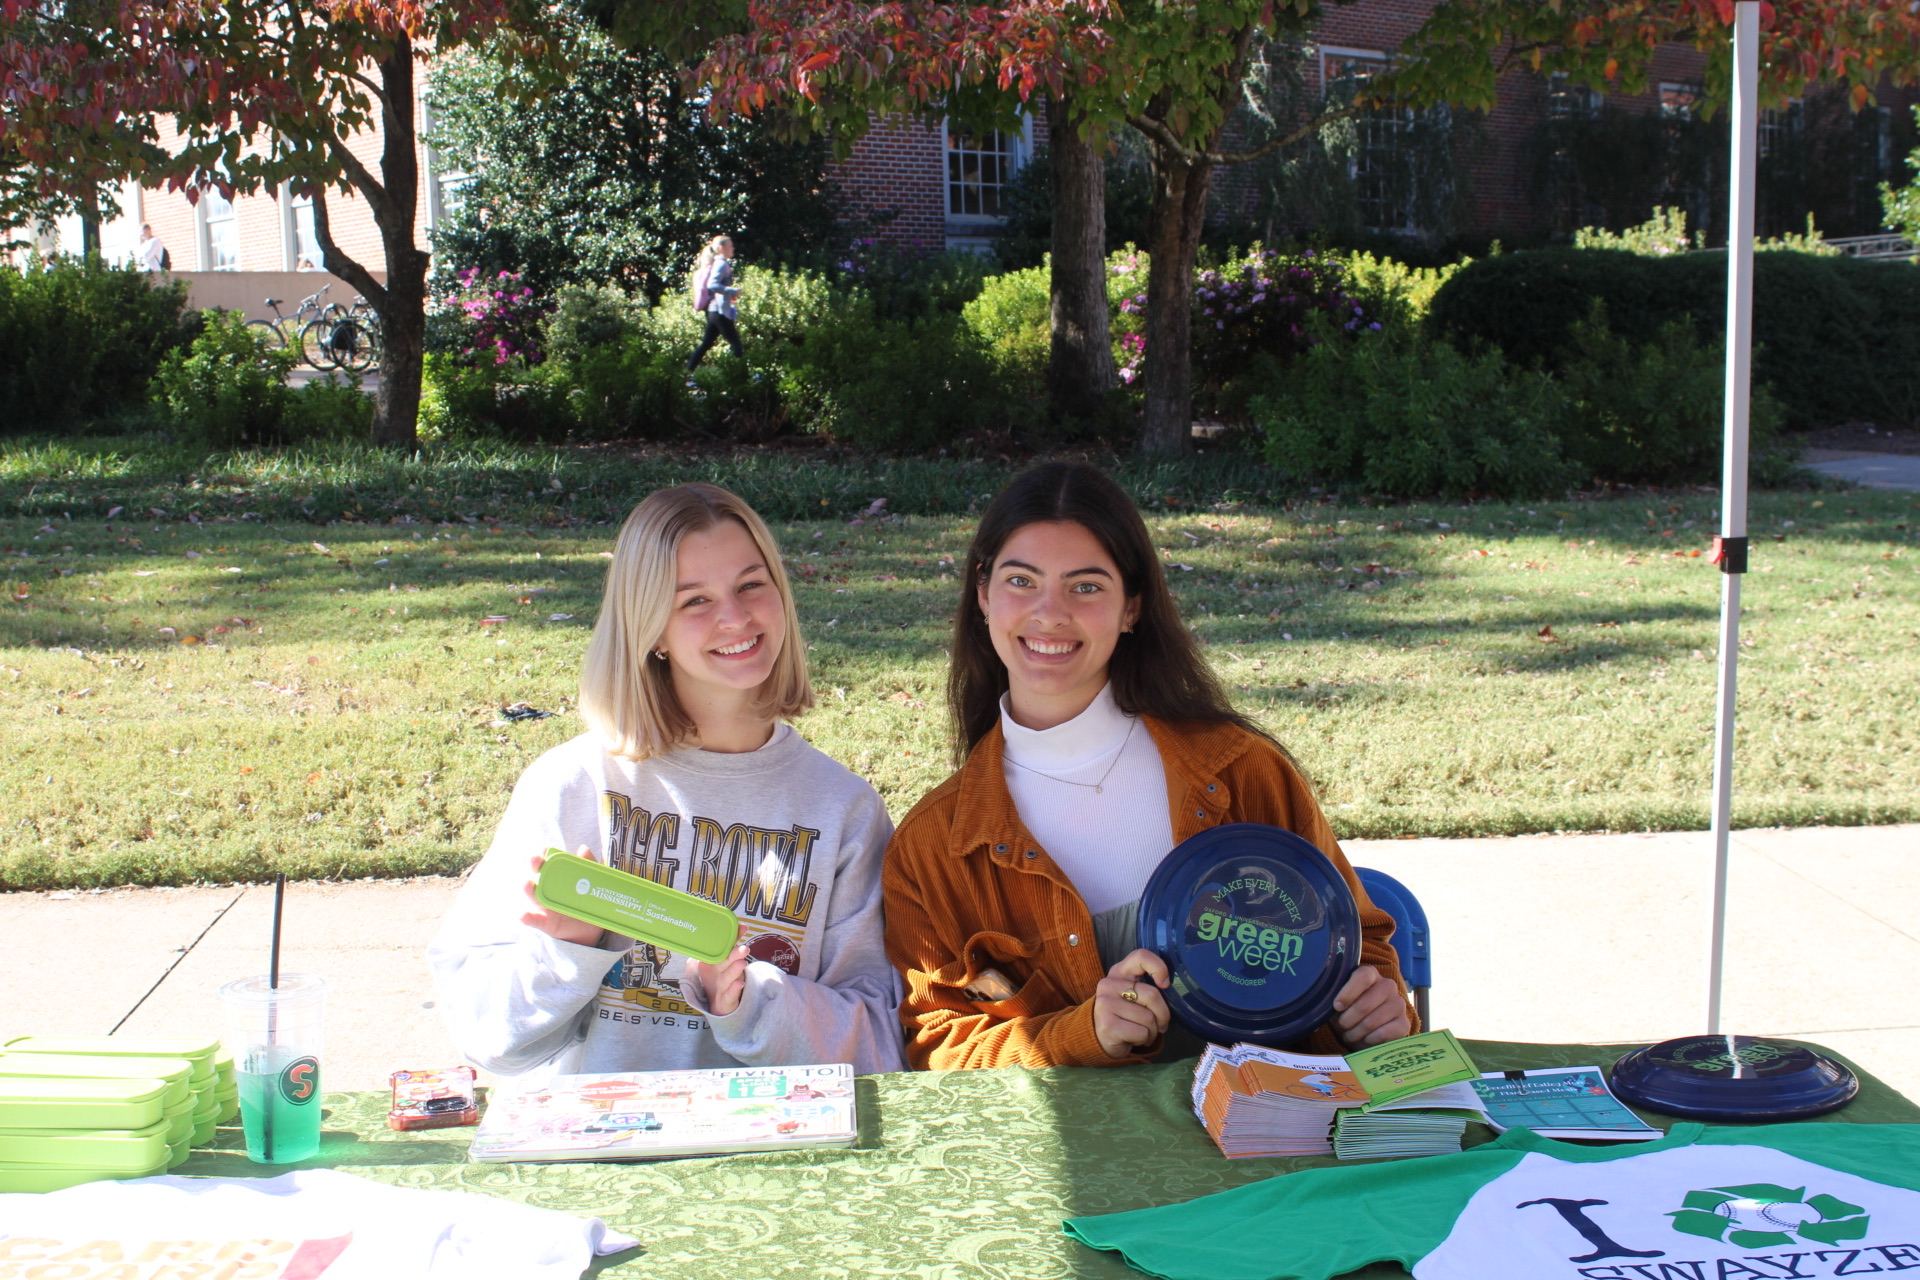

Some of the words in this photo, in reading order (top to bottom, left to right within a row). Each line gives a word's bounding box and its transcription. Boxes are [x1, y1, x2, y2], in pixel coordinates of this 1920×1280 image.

[687, 815, 821, 928] BOWL
[590, 888, 643, 911] MISSISSIPPI
[646, 908, 698, 933] Sustainability
[1212, 879, 1243, 902] MAKE
[1244, 878, 1280, 895] EVERY
[1279, 890, 1302, 922] WEEK
[1197, 912, 1304, 957] green
[1217, 936, 1299, 977] week
[800, 1067, 834, 1077] TO
[1515, 1197, 1666, 1264] I
